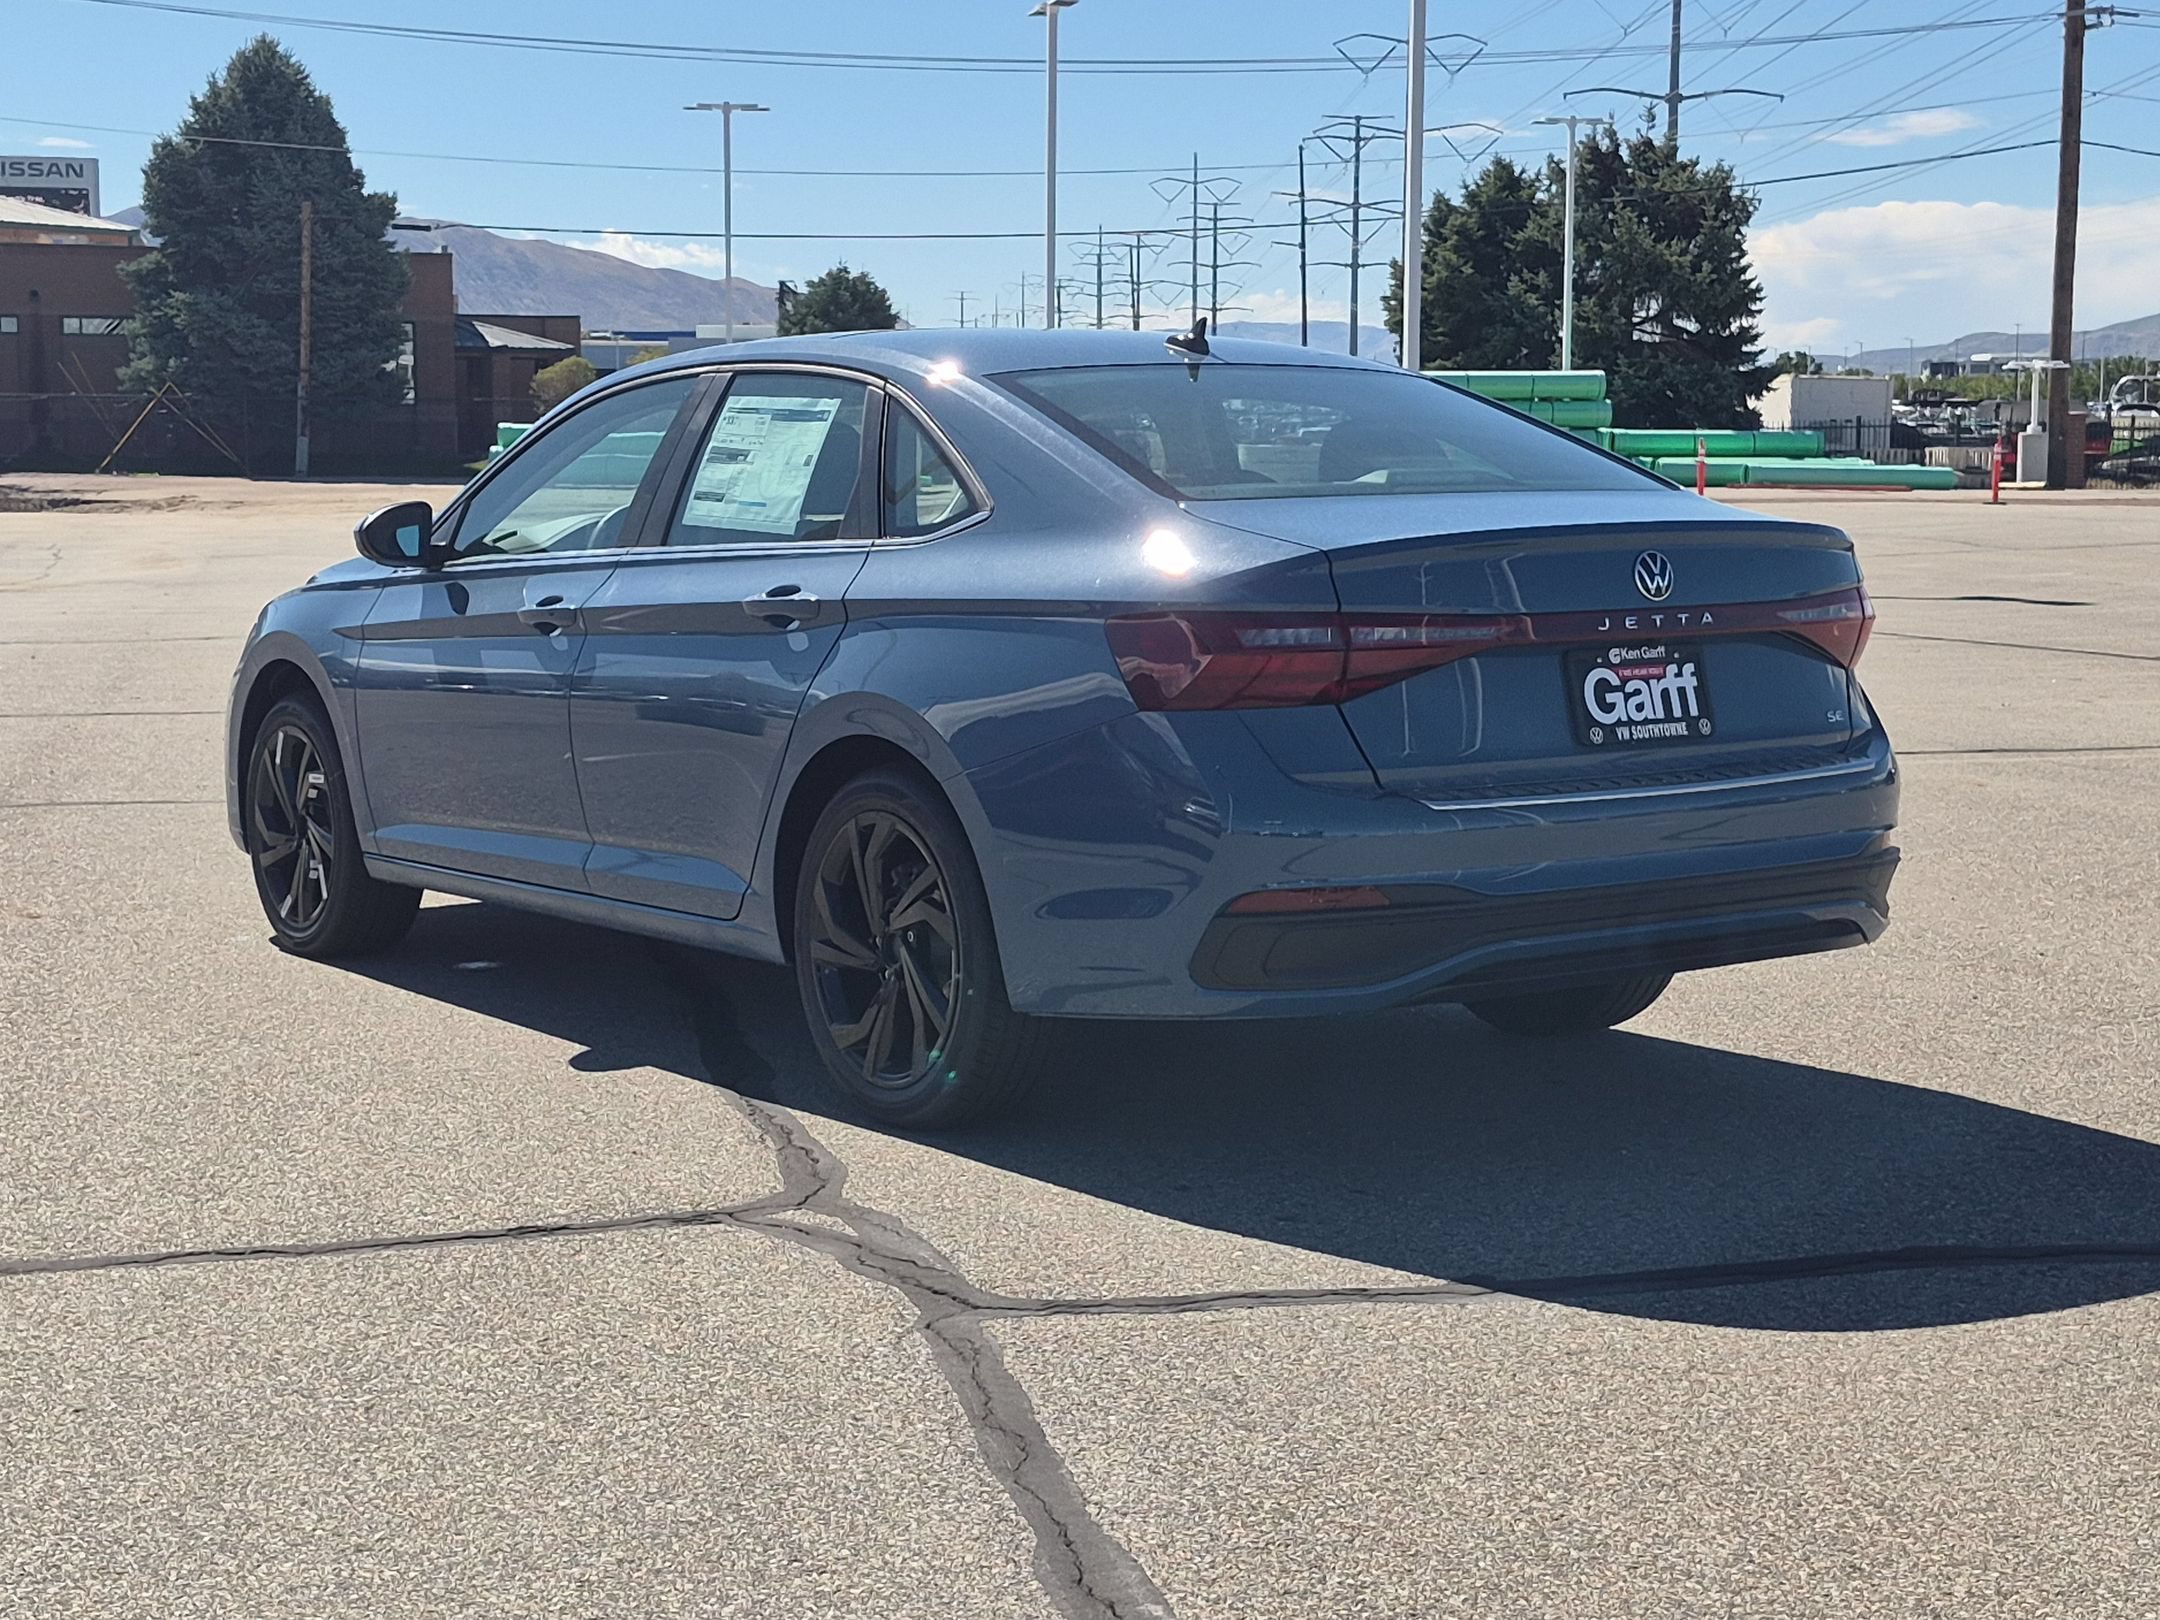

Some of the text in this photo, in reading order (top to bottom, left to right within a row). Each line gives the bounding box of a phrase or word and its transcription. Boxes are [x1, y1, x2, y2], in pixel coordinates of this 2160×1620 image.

[1597, 611, 1714, 631] JETTA
[1620, 647, 1641, 660] Ken
[1641, 645, 1666, 659] Garff
[1584, 662, 1699, 725] Garff
[1827, 710, 1844, 722] SE
[1615, 726, 1630, 741] VW
